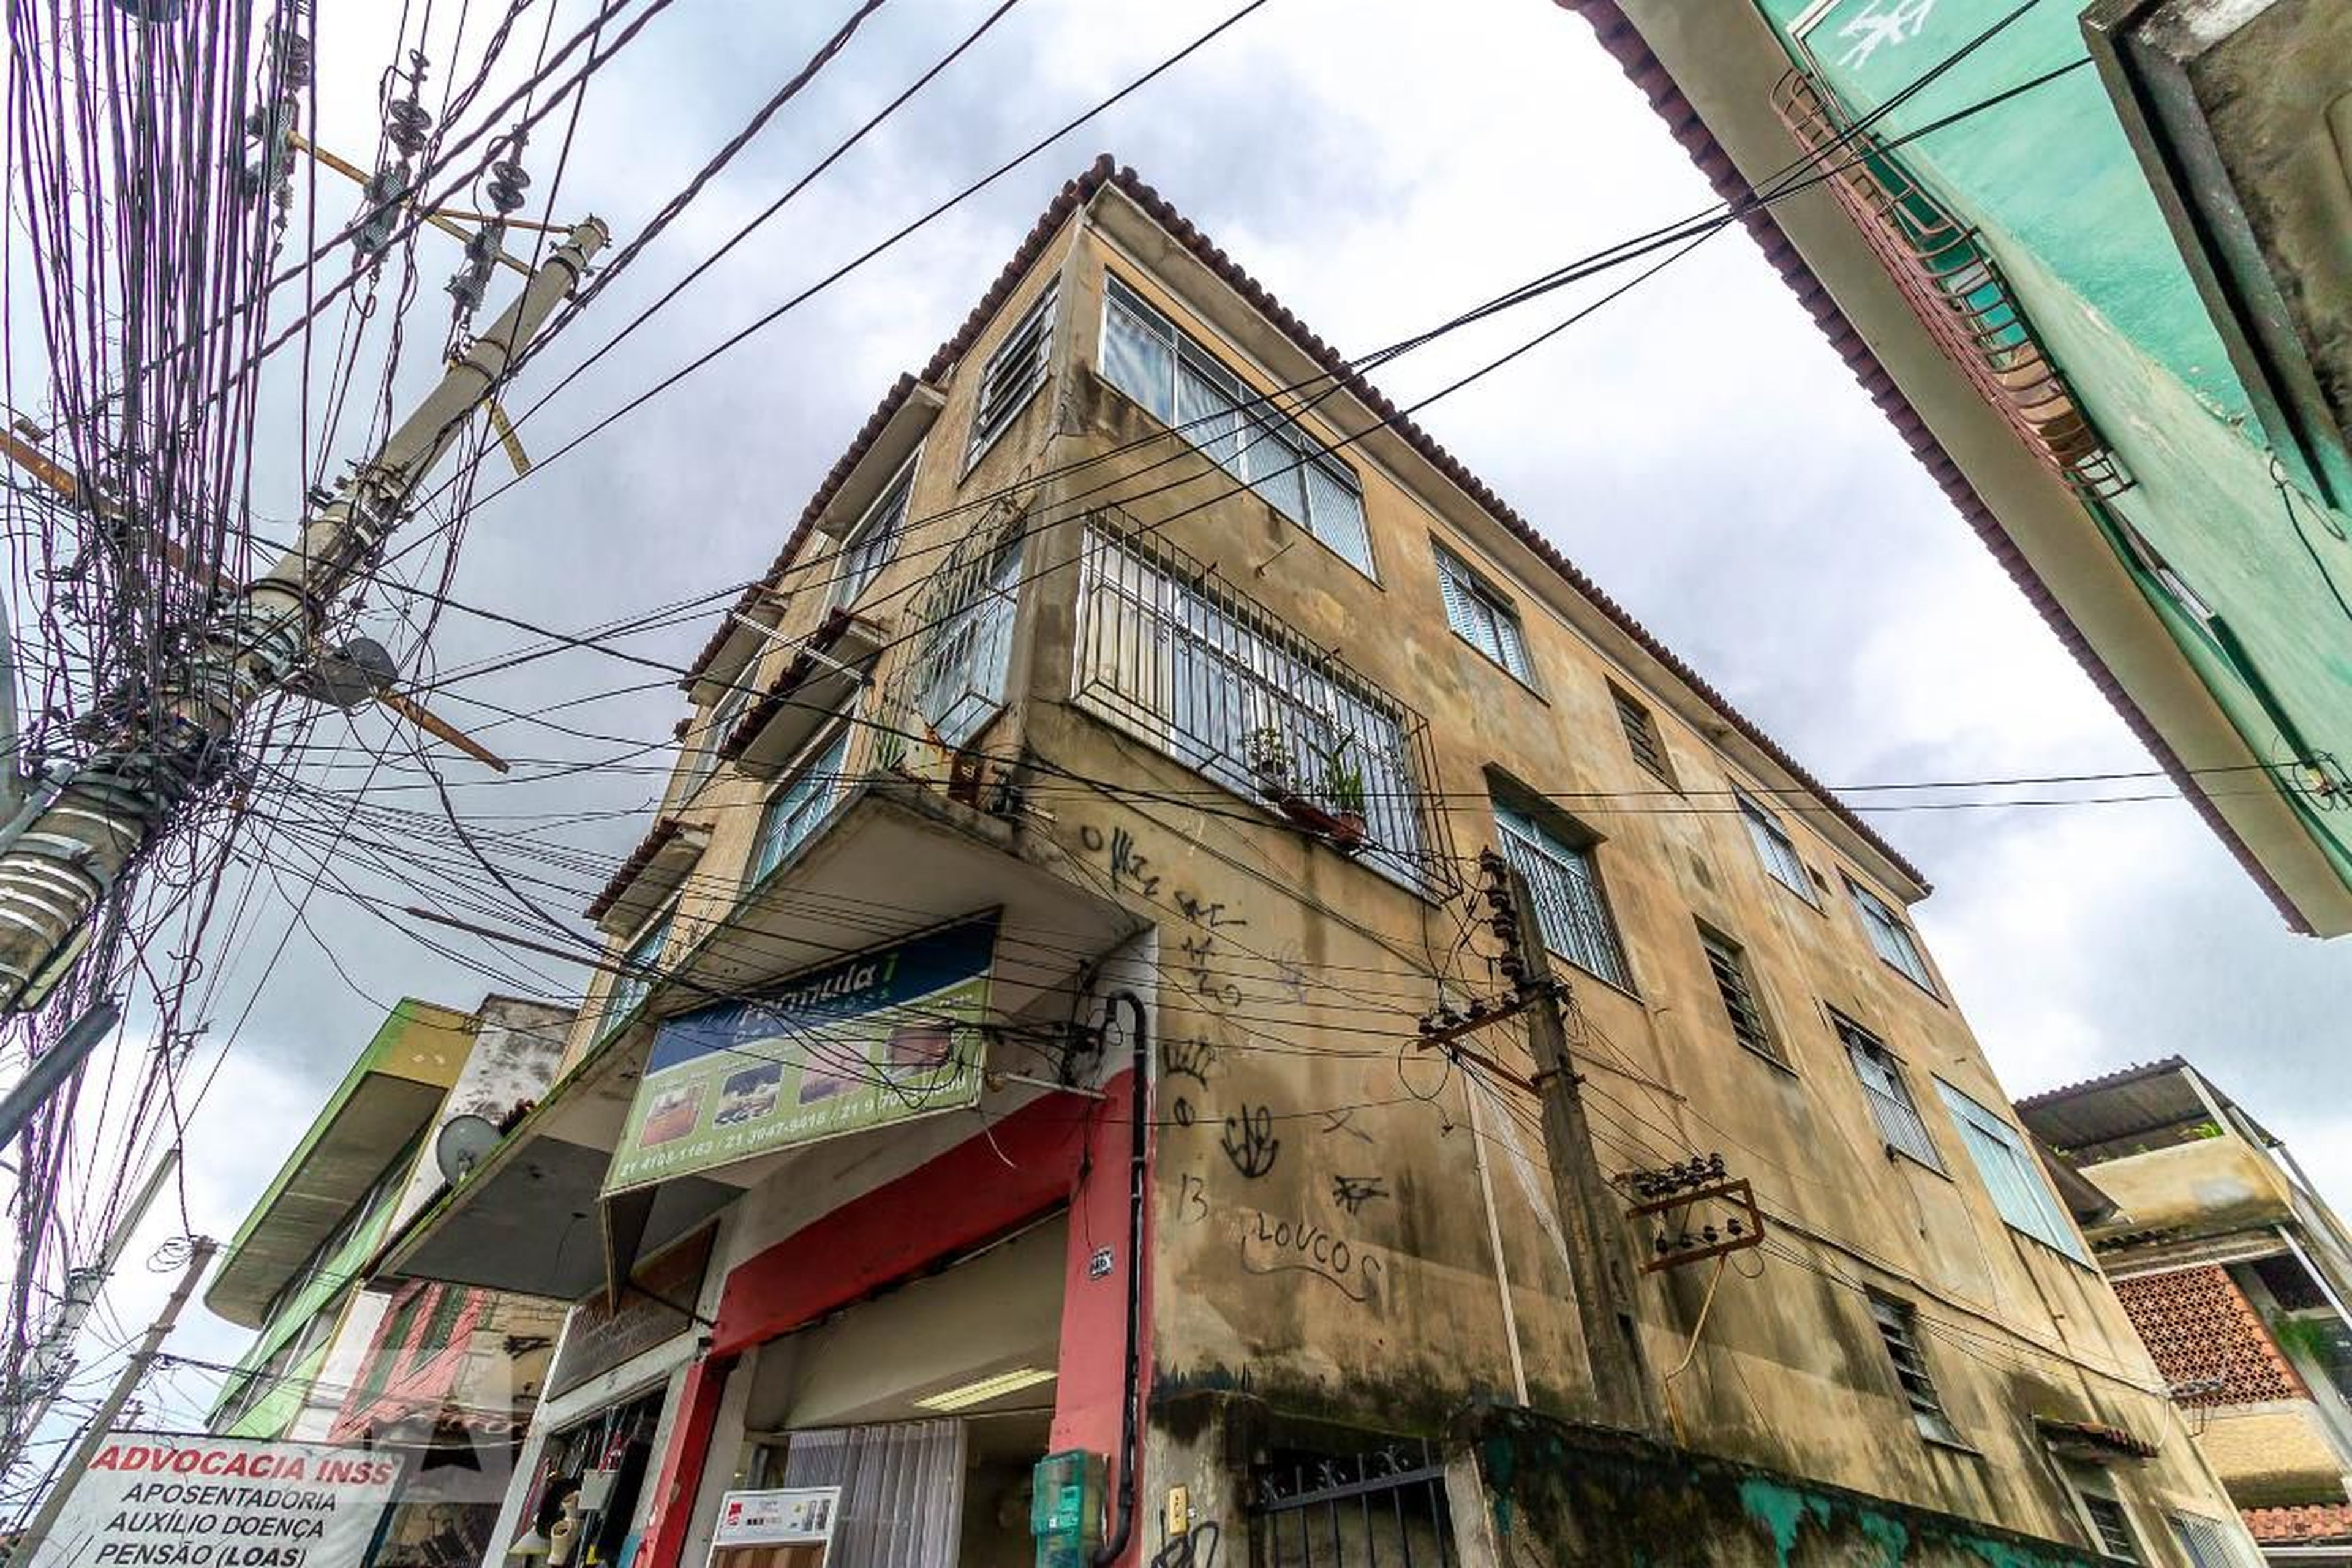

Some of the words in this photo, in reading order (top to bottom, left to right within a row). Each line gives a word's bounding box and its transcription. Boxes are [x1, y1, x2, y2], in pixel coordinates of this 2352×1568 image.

[90, 1446, 304, 1480] ADVOCACIA
[315, 1459, 393, 1485] INSS
[122, 1483, 336, 1512] APOSENTADORIA
[104, 1508, 217, 1534] AUXÍLIO
[221, 1515, 325, 1542] DOENÇA
[95, 1541, 213, 1566] PENSÃO
[216, 1545, 307, 1568] (LOAS)
